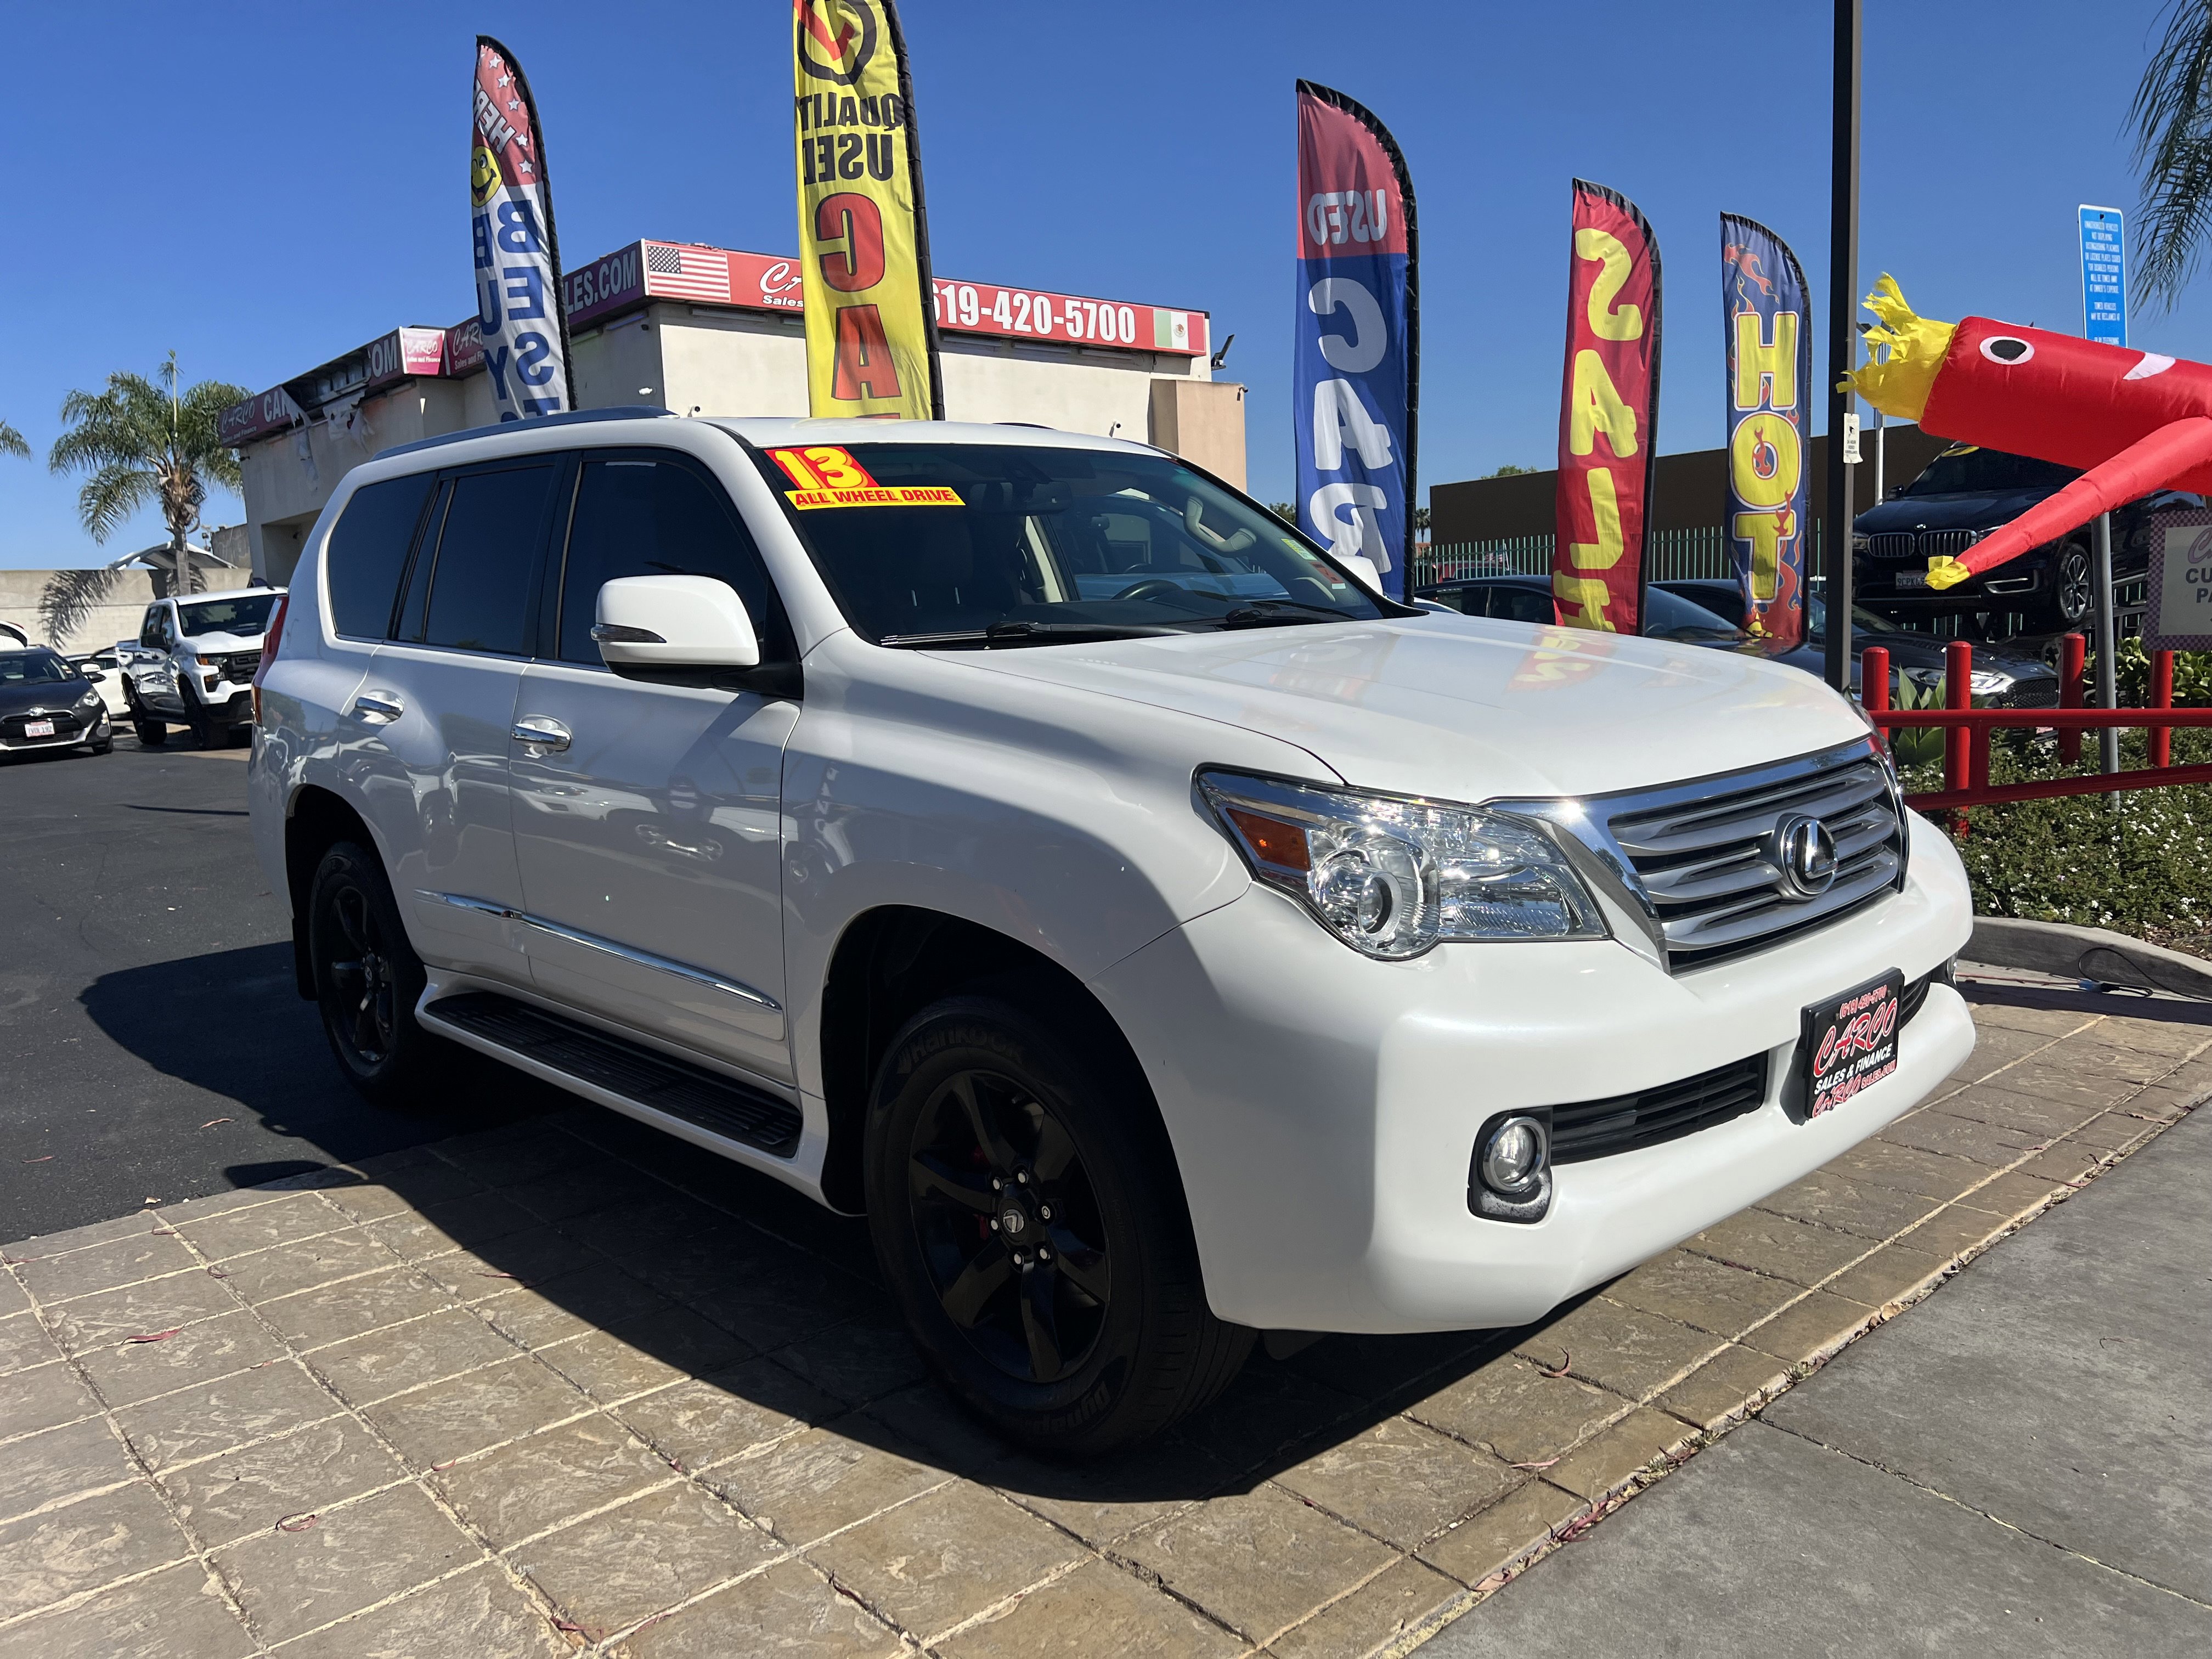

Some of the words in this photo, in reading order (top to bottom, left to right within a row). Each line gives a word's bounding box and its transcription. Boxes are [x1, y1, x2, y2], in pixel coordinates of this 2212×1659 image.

[762, 294, 803, 307] Sales
[222, 399, 255, 434] CARCO
[775, 447, 868, 489] 13
[1729, 311, 1802, 603] HOT
[796, 492, 834, 506] ALL
[832, 489, 900, 504] WHEEL
[902, 489, 955, 503] DRIVE
[1814, 997, 1898, 1077] CARCO
[1814, 1069, 1846, 1094] SALES
[1847, 1064, 1853, 1080] &
[1855, 1043, 1893, 1075] FINANCE
